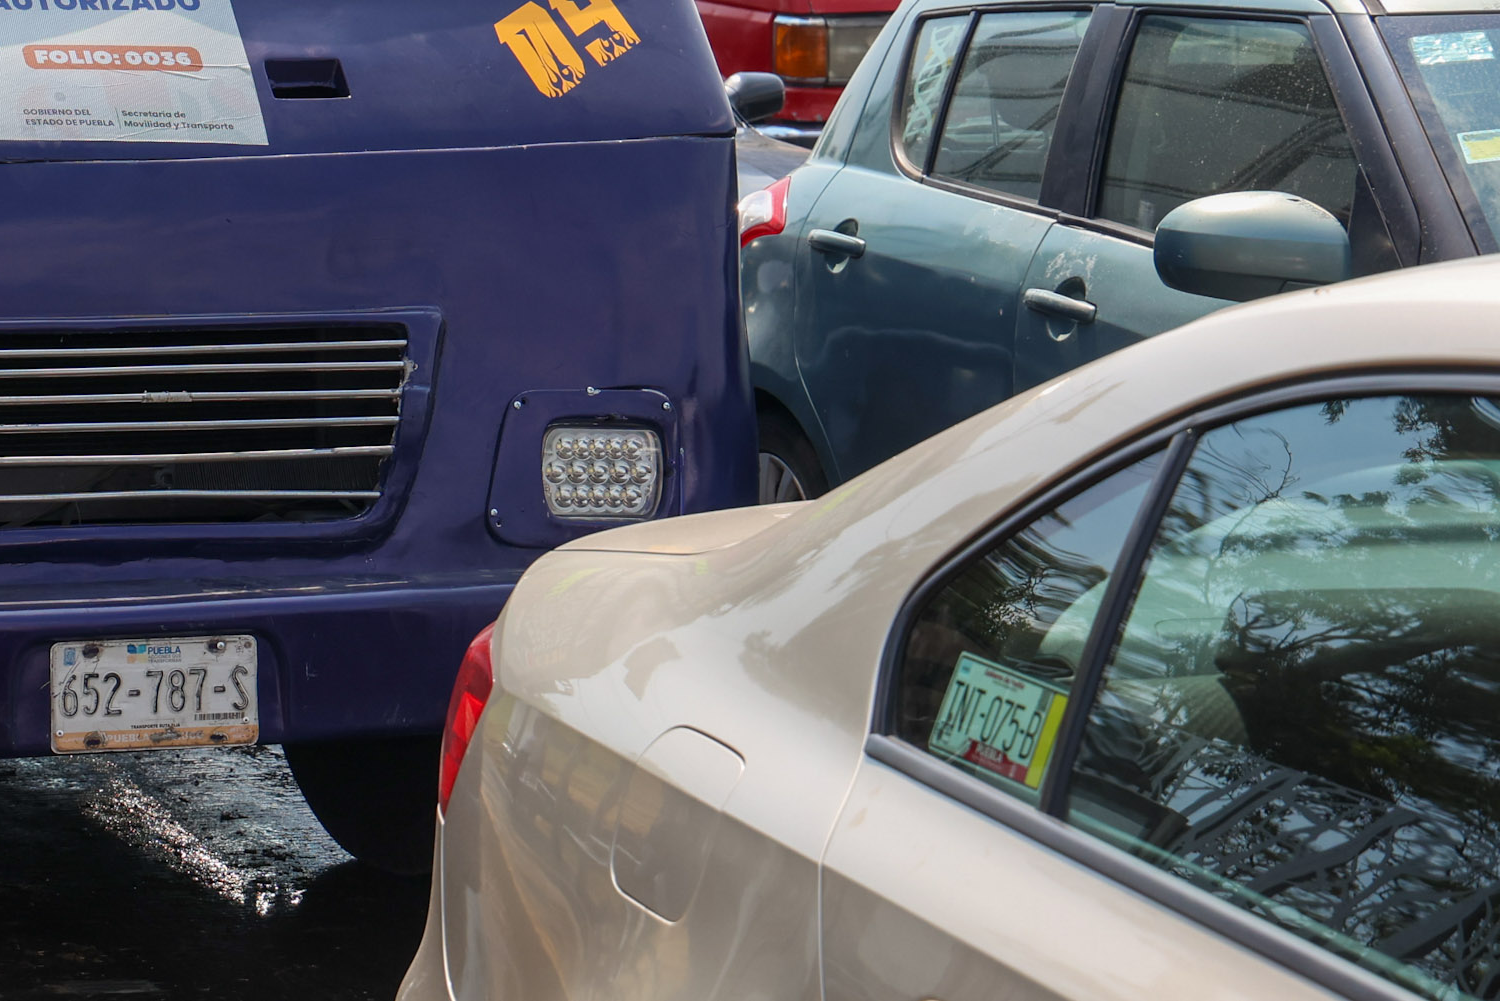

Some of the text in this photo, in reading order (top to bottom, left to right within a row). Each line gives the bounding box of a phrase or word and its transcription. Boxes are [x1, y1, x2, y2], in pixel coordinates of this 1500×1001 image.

[34, 49, 192, 68] FOLIO: 0036
[173, 111, 186, 119] de
[79, 119, 115, 127] PUEBLA
[124, 120, 234, 131] Movilidad y Transporte
[147, 645, 182, 655] PUEBLA
[59, 665, 249, 717] 652-787-S
